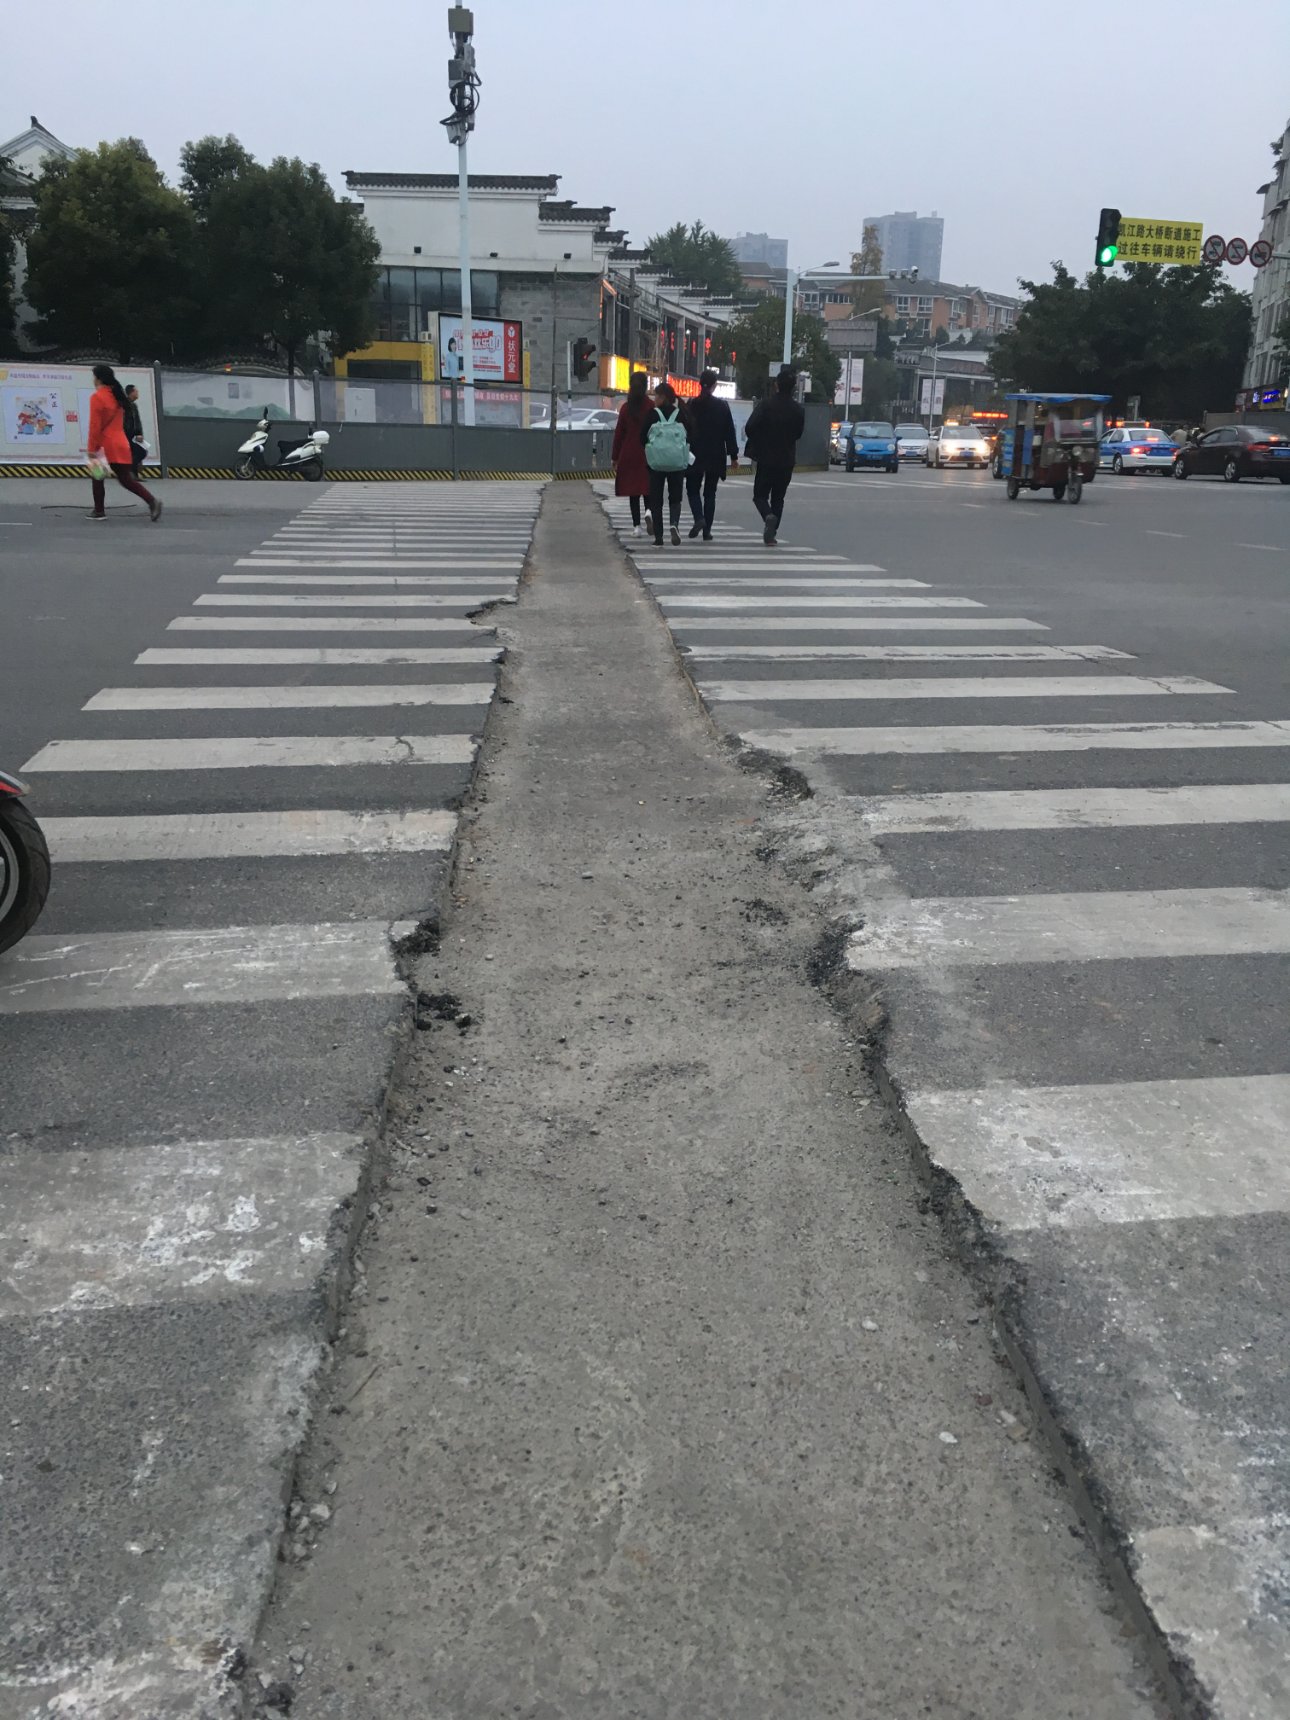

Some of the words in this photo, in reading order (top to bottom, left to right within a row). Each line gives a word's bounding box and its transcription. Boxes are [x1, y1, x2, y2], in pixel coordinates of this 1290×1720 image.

[1118, 241, 1197, 260] 过往车辆请绕行
